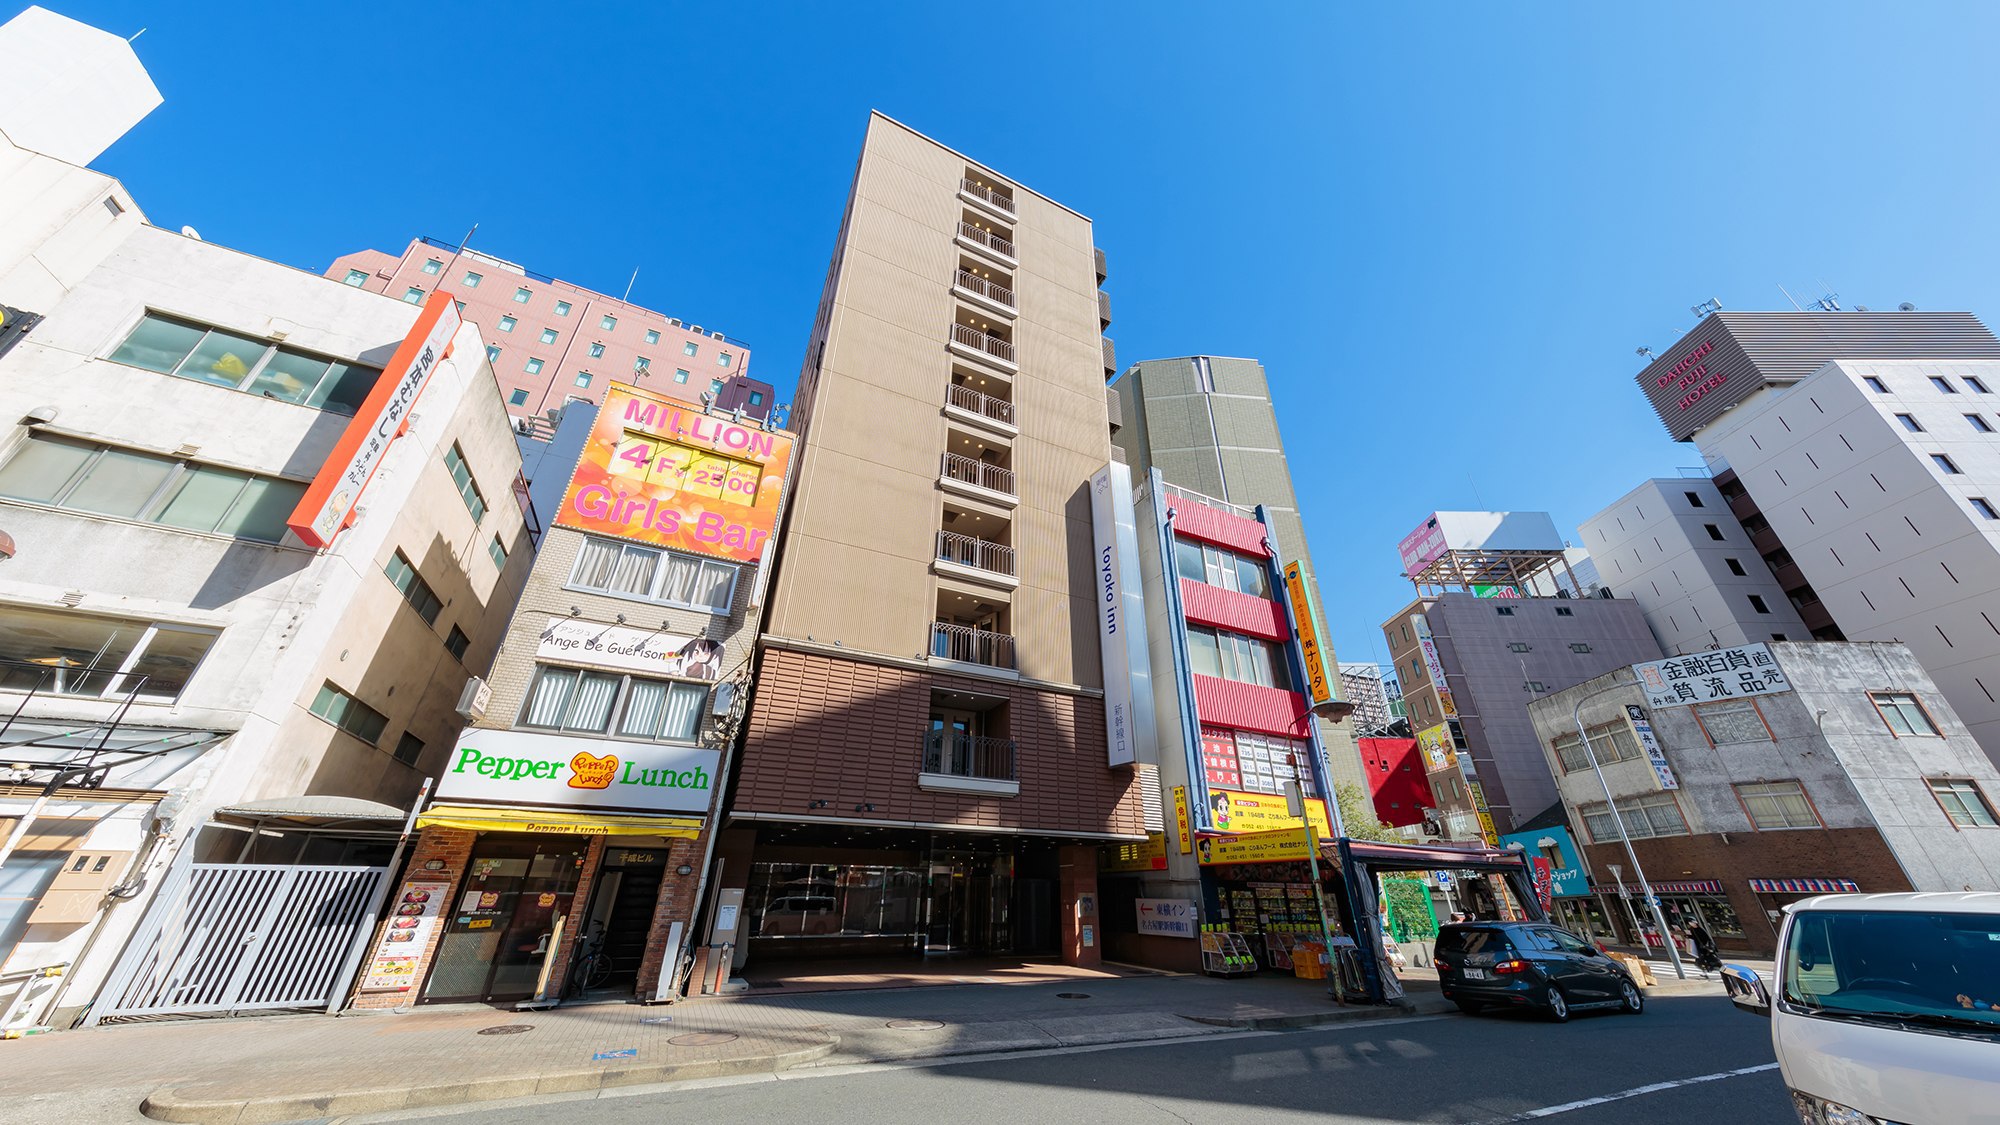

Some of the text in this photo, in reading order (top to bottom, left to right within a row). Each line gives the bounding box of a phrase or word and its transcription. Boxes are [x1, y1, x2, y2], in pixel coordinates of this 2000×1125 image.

[1657, 340, 1713, 389] DAIICHI
[1677, 364, 1708, 391] FUJI
[378, 345, 434, 438] 宮本むなし
[1678, 372, 1727, 411] HOTEL
[624, 398, 774, 457] MILLION
[574, 483, 768, 551] Girls Bar
[1101, 545, 1116, 635] toyoko inn
[543, 634, 666, 660] Ange De Guérison
[1662, 649, 1753, 681] 金融百貨
[1652, 696, 1677, 706] 舟橋
[1672, 672, 1767, 702] 質流品
[1114, 703, 1125, 752] 新幹線口
[452, 748, 709, 790] Pepper Lunch
[525, 823, 609, 835] Pepper Lunch
[619, 853, 654, 863] 千成ビル
[1156, 903, 1185, 916] 東横イン
